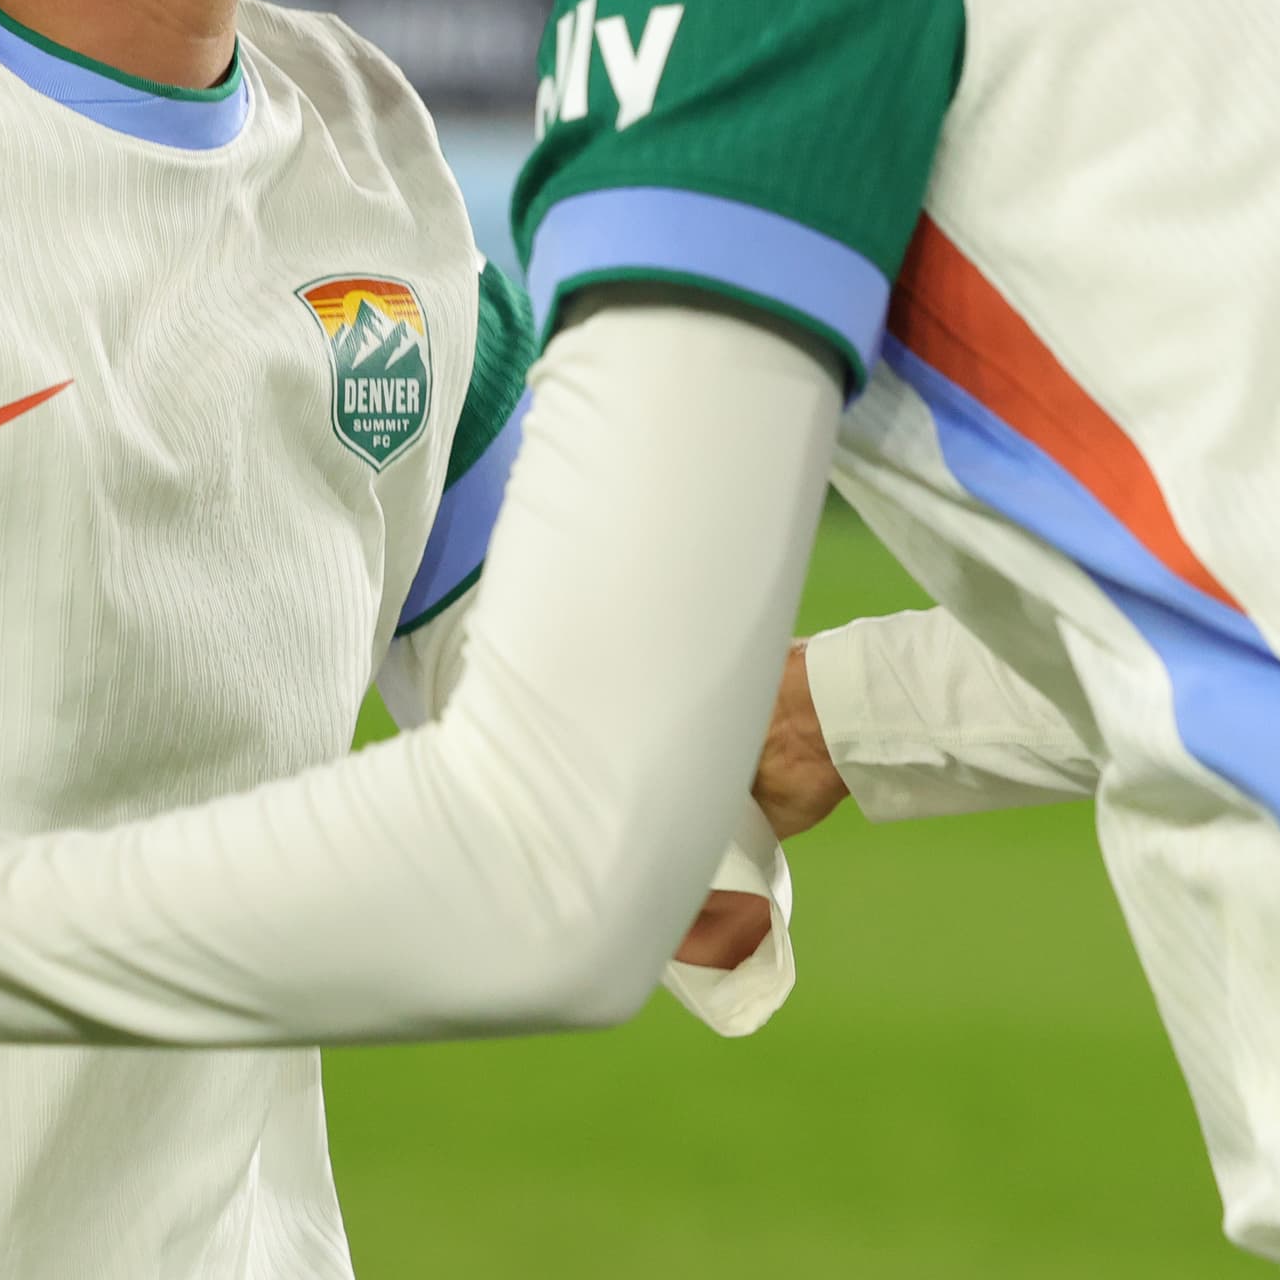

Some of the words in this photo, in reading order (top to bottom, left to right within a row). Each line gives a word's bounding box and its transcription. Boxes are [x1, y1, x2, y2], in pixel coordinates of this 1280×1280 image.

[344, 378, 420, 414] DENVER
[353, 419, 410, 432] SUMMIT
[373, 435, 390, 448] FC
